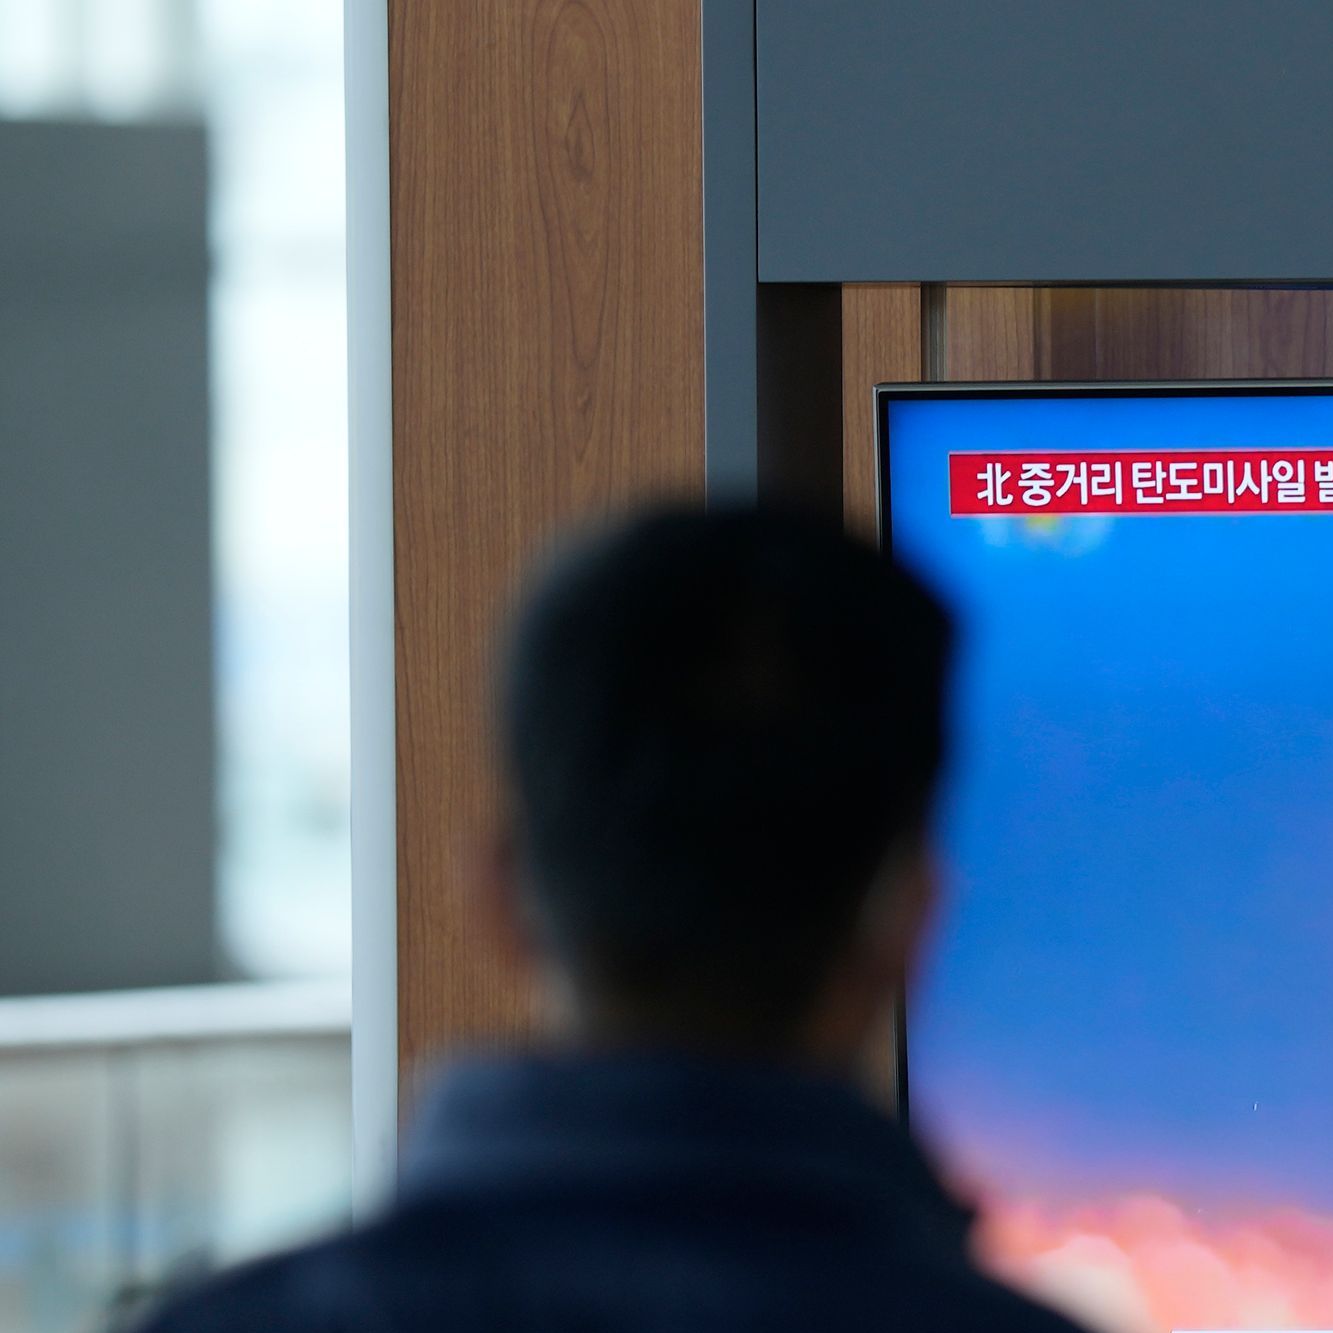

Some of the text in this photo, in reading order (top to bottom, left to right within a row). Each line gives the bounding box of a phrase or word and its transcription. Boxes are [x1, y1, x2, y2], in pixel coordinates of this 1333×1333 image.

[976, 463, 1013, 505] 北
[1018, 462, 1122, 505] 중거리
[1132, 460, 1305, 504] 탄도미사일
